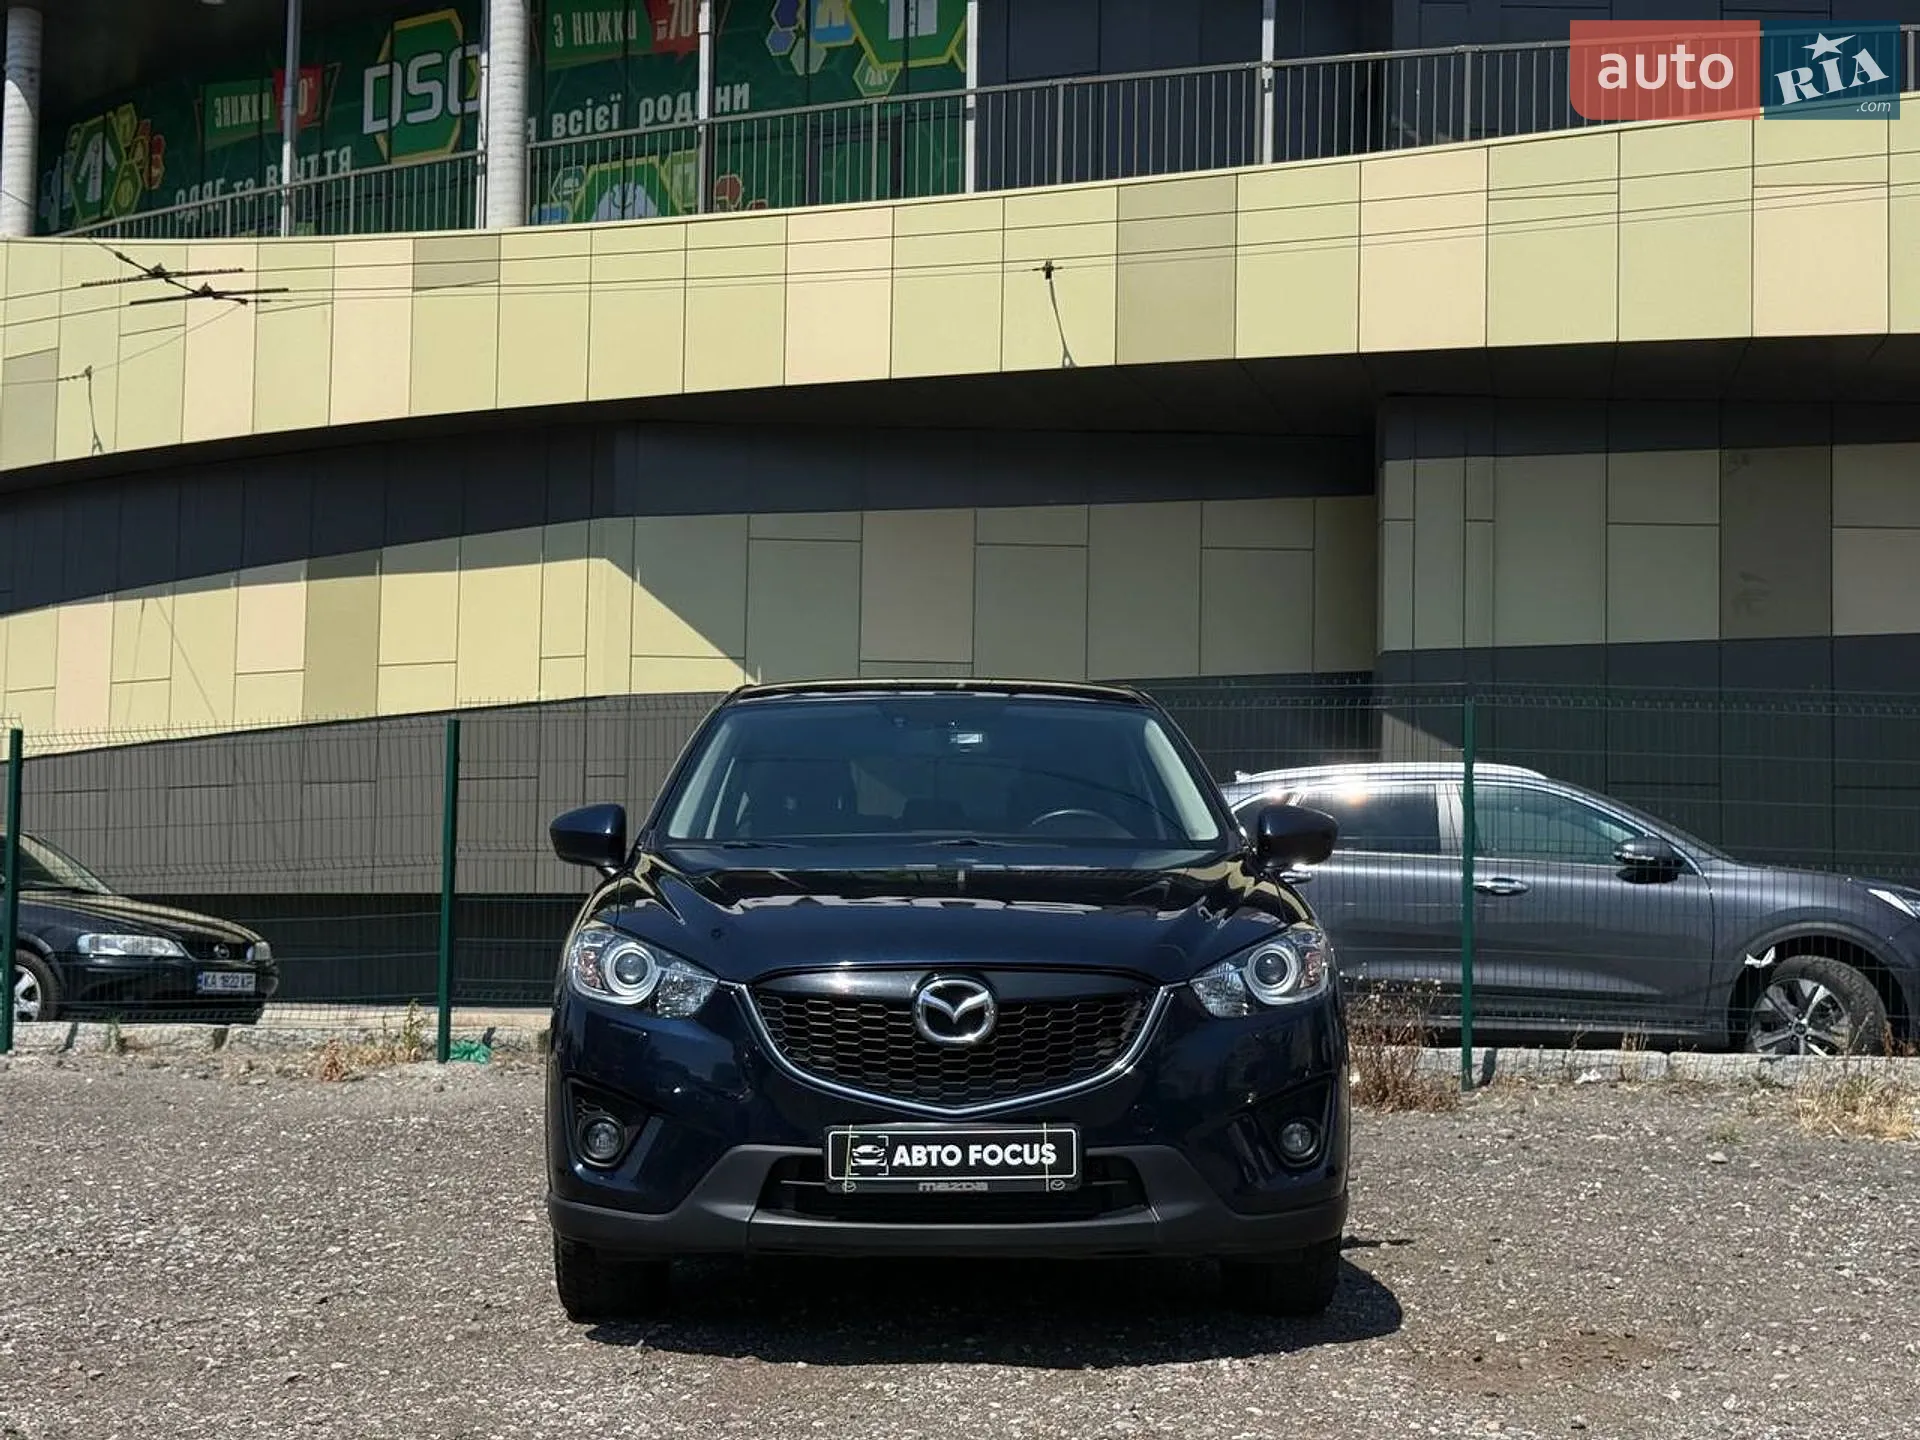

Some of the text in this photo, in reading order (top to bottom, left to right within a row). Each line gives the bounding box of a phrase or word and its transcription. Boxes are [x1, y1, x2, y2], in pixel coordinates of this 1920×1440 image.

[639, 82, 750, 130] родни
[892, 1143, 1057, 1167] АВТО FOCUS
